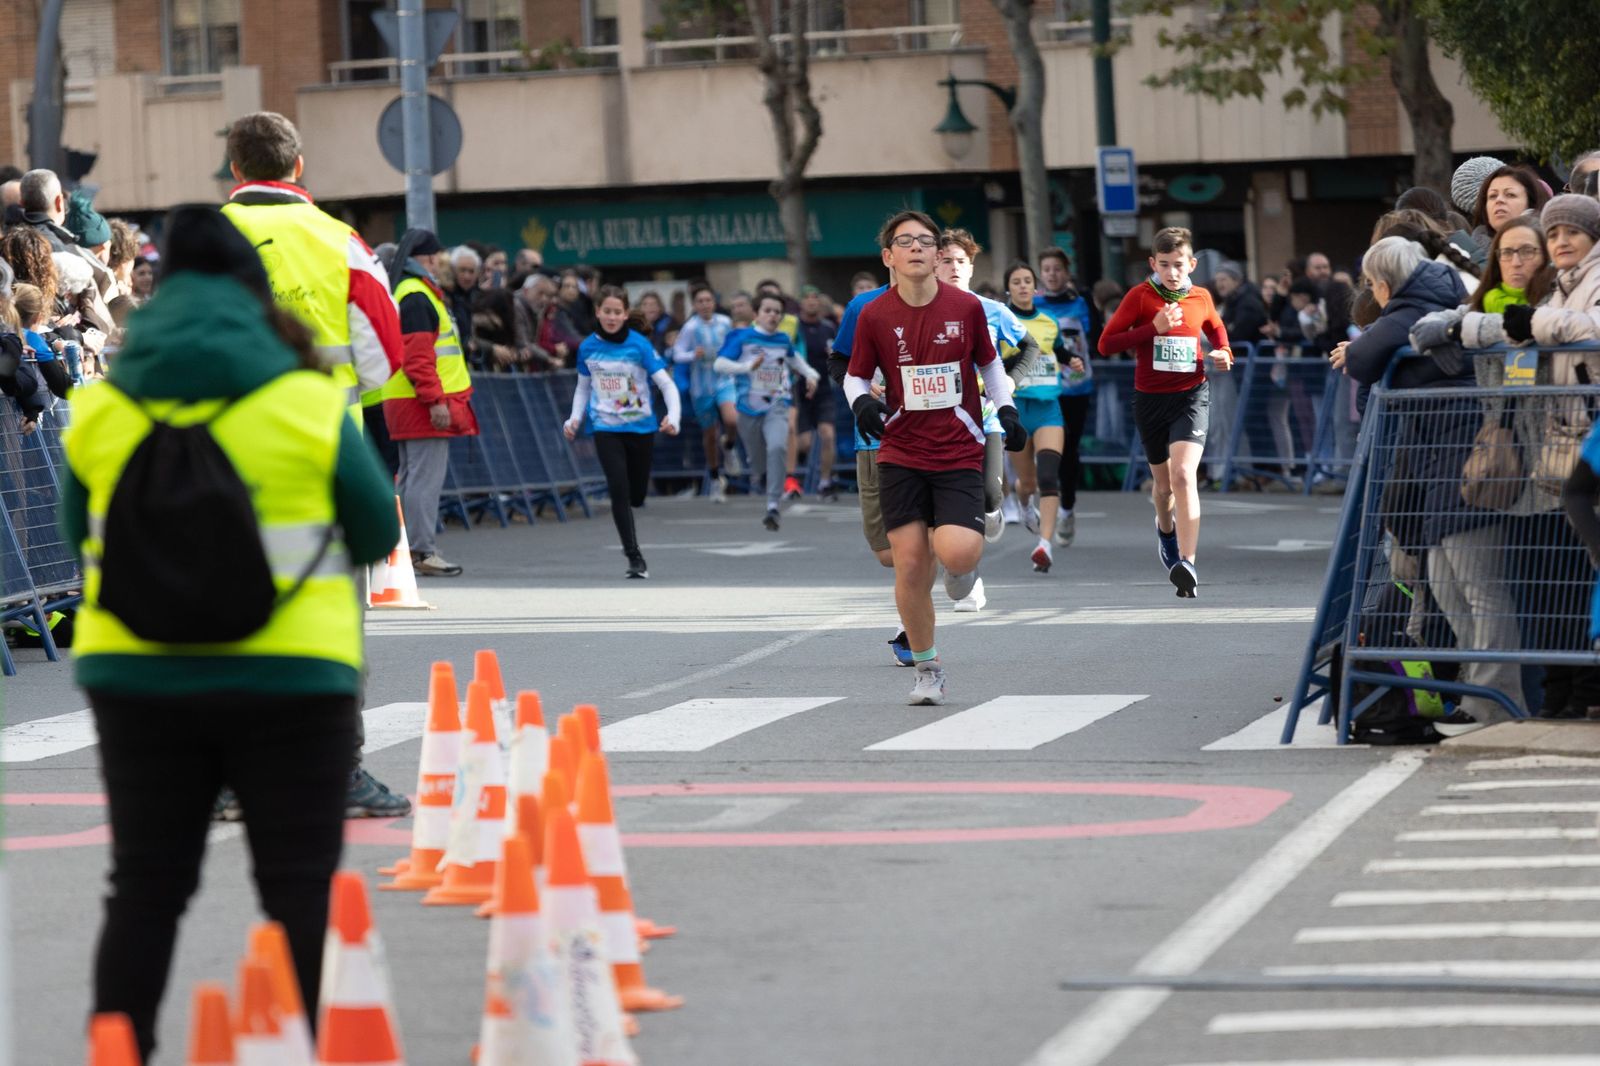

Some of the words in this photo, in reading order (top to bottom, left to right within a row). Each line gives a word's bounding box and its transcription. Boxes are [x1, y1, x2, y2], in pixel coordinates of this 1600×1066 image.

[554, 220, 601, 257] CAJA
[603, 216, 666, 250] RURAL
[669, 216, 695, 246] DE
[697, 212, 820, 244] SALAMAA
[1161, 345, 1187, 361] 6153
[916, 366, 955, 376] SETEL
[912, 376, 947, 395] 6149
